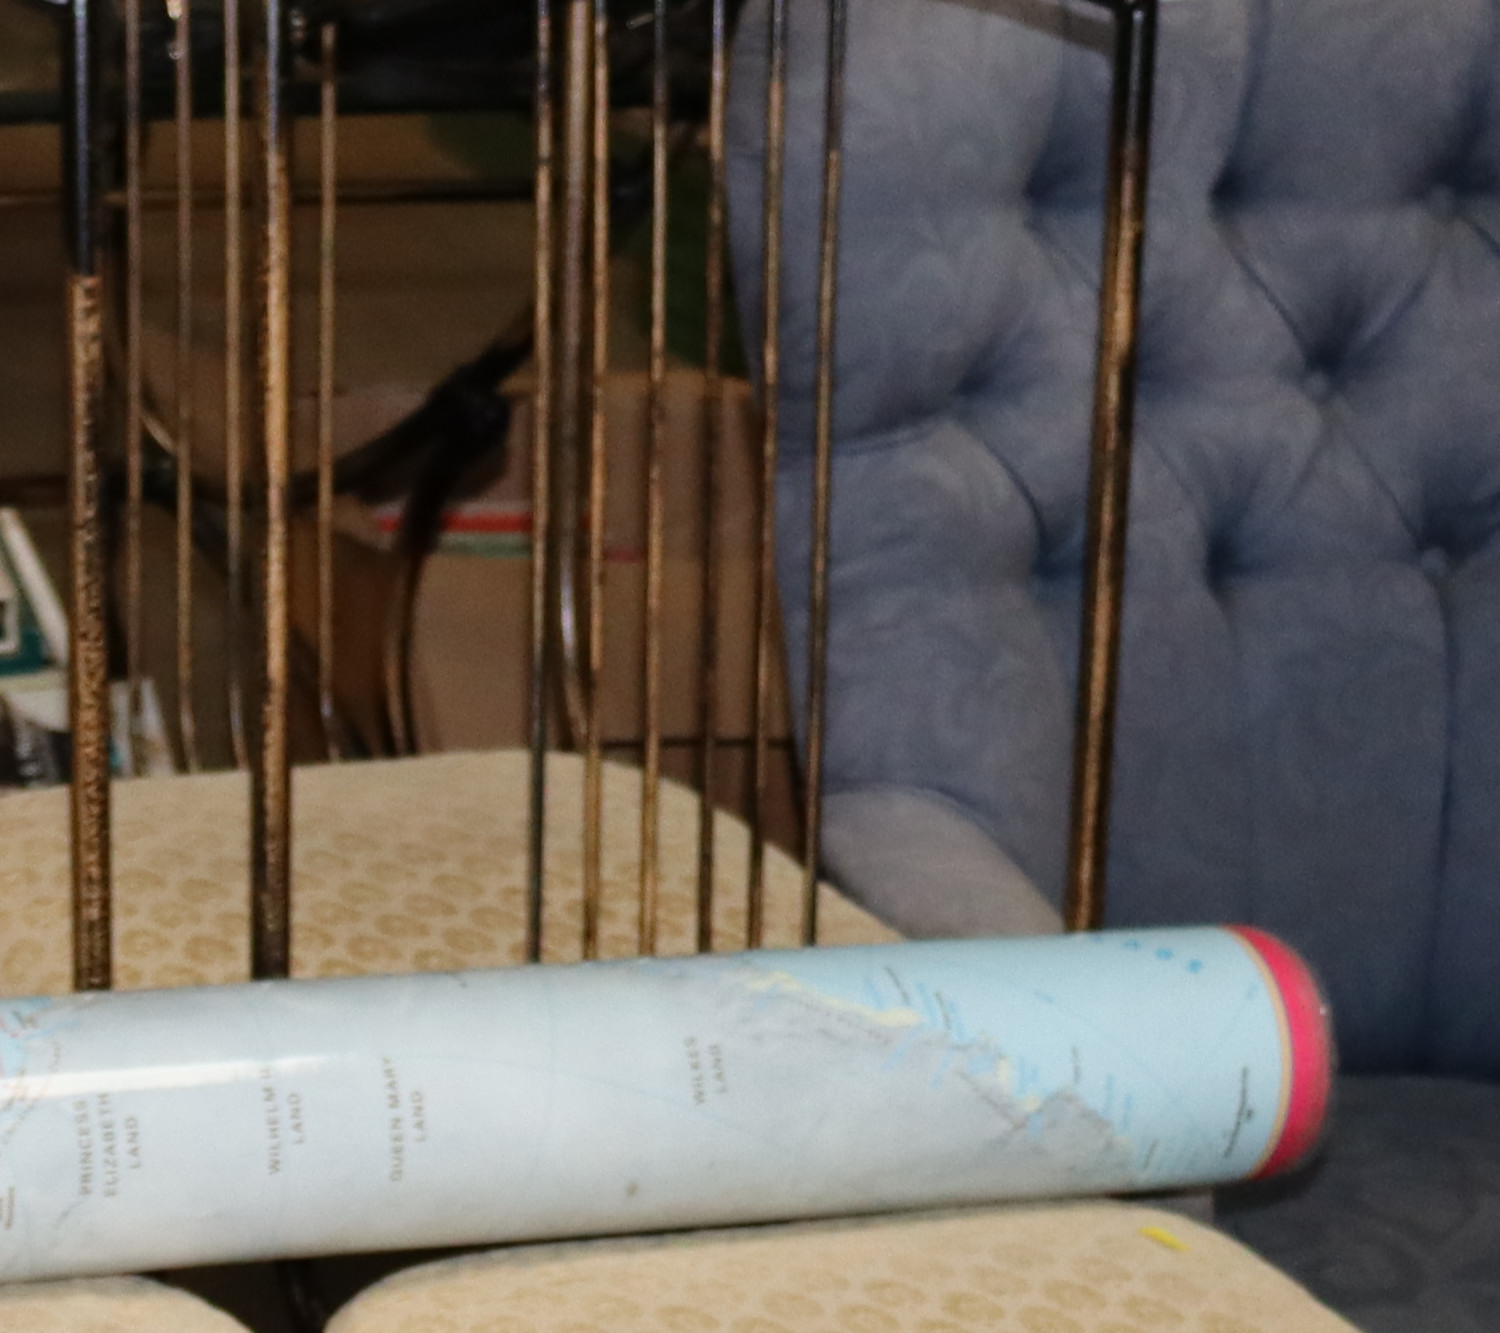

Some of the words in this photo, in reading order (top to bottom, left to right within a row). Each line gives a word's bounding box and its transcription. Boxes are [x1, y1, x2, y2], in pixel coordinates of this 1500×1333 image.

[381, 1056, 400, 1110] MARY
[97, 1092, 118, 1198] ELIZABETH
[124, 1115, 142, 1170] LAND
[261, 1085, 282, 1175] WILHELM
[287, 1092, 305, 1145] LAND
[410, 1089, 428, 1143] LAND
[73, 1099, 93, 1197] PRINCESS
[389, 1116, 403, 1183] QUEEN
